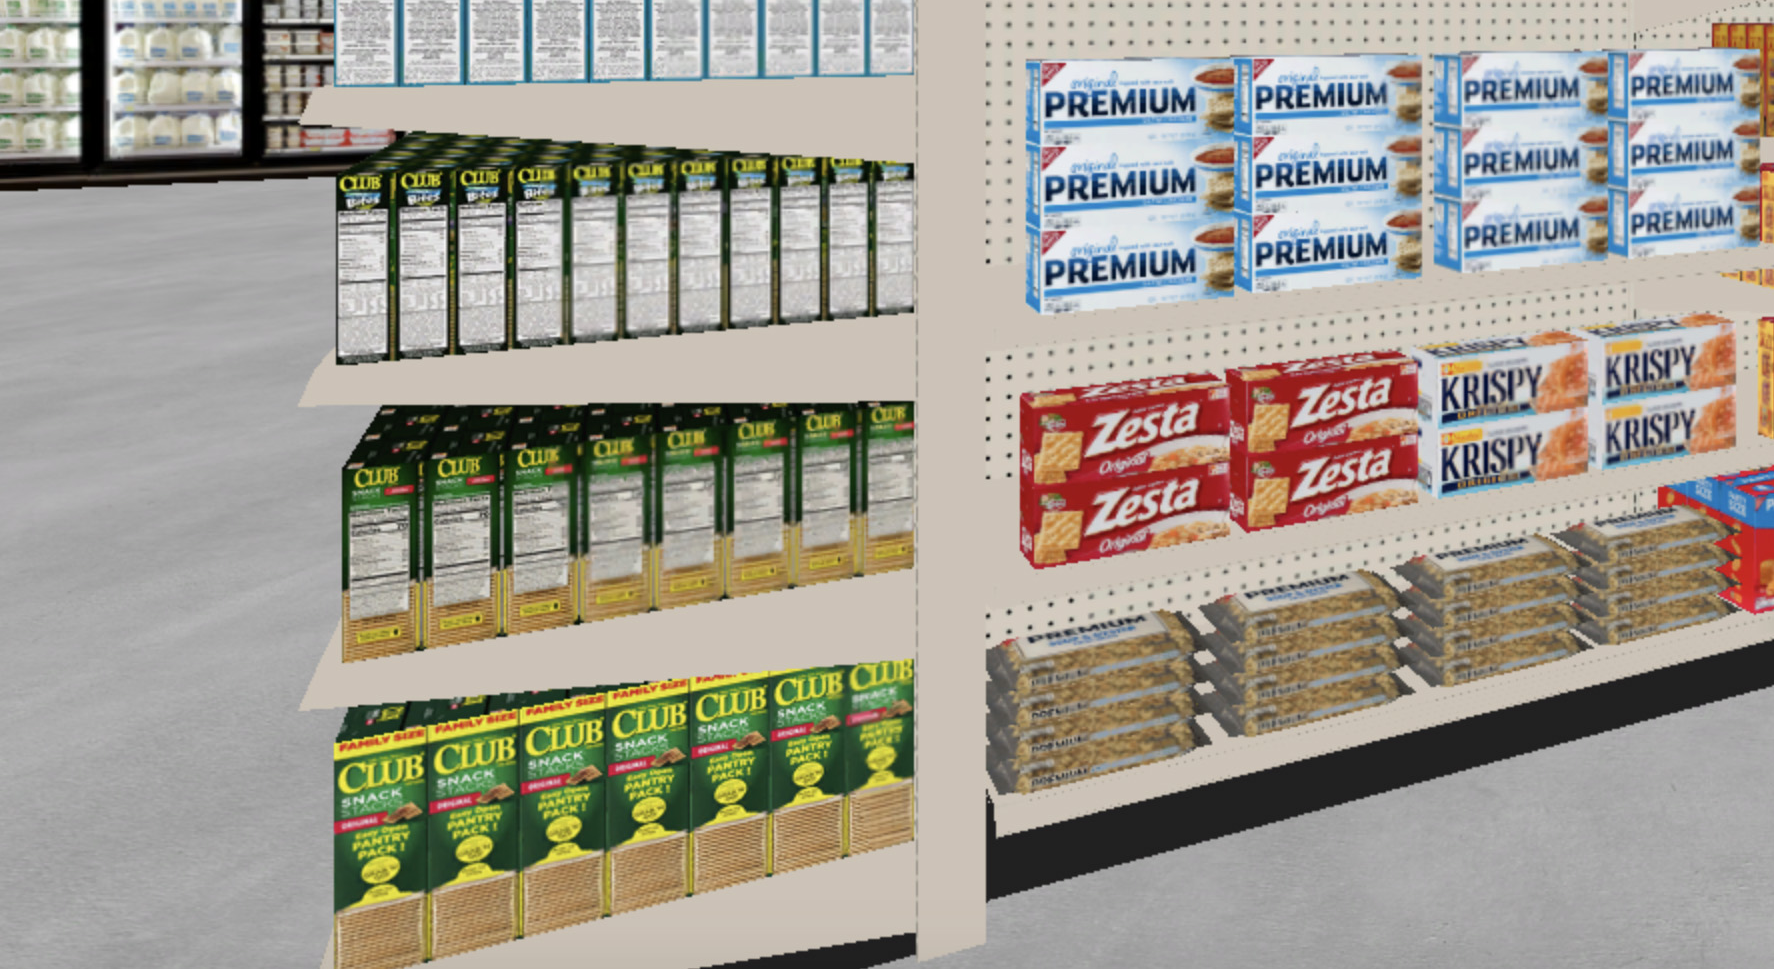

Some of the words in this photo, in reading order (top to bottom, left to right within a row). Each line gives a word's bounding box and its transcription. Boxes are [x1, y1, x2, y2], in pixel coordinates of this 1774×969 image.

[1255, 82, 1388, 110] PREMIUM
[1464, 76, 1580, 103] PREMIUM
[1631, 73, 1734, 98] PREMIUM
[1044, 86, 1196, 118] PREMIUM
[1464, 147, 1580, 176] PREMIUM
[1631, 140, 1734, 166] PREMIUM
[339, 175, 382, 192] CLUB
[401, 172, 443, 189] CLUB
[460, 170, 500, 186] CLUB
[1044, 168, 1196, 202] PREMIUM
[1255, 157, 1388, 188] PREMIUM
[1464, 217, 1580, 249] PREMIUM
[1631, 206, 1734, 235] PREMIUM
[1255, 232, 1388, 267] PREMIUM
[1044, 249, 1196, 286] PREMIUM
[1605, 344, 1697, 388] KRISPY
[1441, 364, 1543, 412] KRISPY
[1290, 377, 1393, 429] Zesta
[1084, 401, 1201, 458] Zesta
[1303, 420, 1349, 446] Original
[1605, 408, 1697, 453] KRISPY
[437, 457, 482, 478] CLUB
[517, 449, 560, 468] CLUB
[1099, 451, 1151, 477] Original
[1441, 432, 1543, 480] KRISPY
[354, 467, 400, 488] CLUB
[1290, 448, 1393, 502] Zesta
[1084, 478, 1201, 537] Zesta
[1303, 493, 1349, 519] Original
[1099, 530, 1151, 554] Original
[850, 659, 913, 691] CLUB
[613, 686, 658, 699] FAMILY
[774, 671, 844, 706] CLUB
[526, 702, 572, 716] FAMILY
[576, 695, 605, 707] SIZE
[696, 685, 767, 722] CLUB
[777, 701, 826, 718] SNACK
[434, 715, 483, 735] FAMILY
[485, 710, 517, 726] SIZE
[612, 701, 687, 739] CLUB
[698, 717, 749, 734] SNACK
[339, 734, 390, 752] FAMILY
[394, 729, 425, 742] SIZE
[525, 718, 604, 756] CLUB
[615, 734, 668, 752] SNACK
[786, 741, 832, 757] PANTRY
[434, 735, 517, 775] CLUB
[528, 751, 584, 769] SNACK
[707, 757, 756, 775] PANTRY
[338, 752, 425, 794] CLUB
[437, 769, 495, 789] SNACK
[624, 774, 675, 793] PANTRY
[342, 788, 402, 808] SNACK
[538, 793, 591, 811] PANTRY
[447, 812, 502, 831] PANTRY
[353, 831, 410, 851] PANTRY
